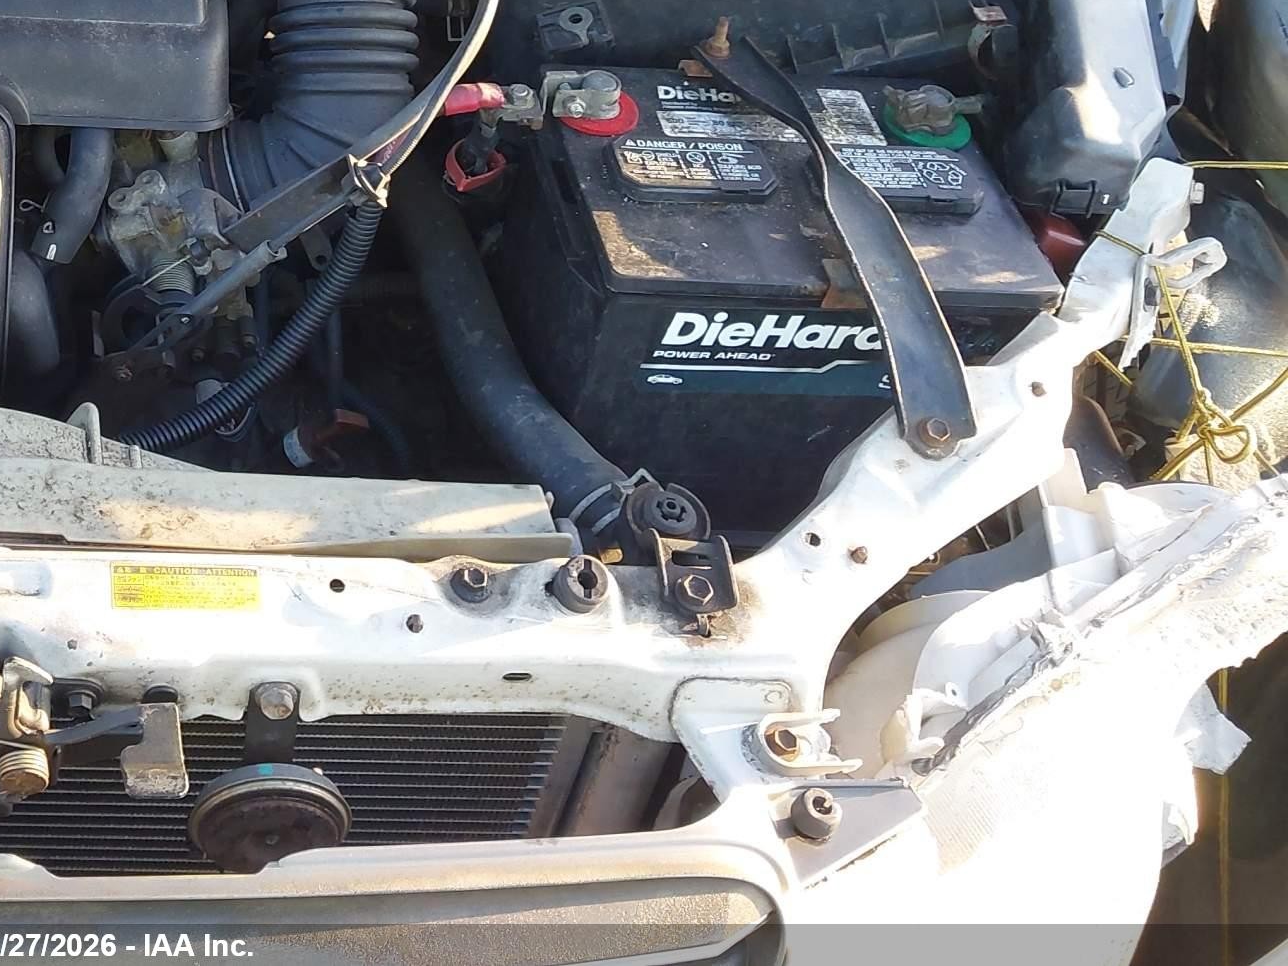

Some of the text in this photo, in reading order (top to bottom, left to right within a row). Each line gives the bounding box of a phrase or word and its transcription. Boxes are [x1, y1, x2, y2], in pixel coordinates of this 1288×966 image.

[656, 85, 742, 104] DieHa
[636, 139, 687, 150] DANGER
[698, 142, 744, 151] POISON
[652, 350, 711, 360] POWER
[153, 567, 200, 575] CAUTION
[205, 568, 256, 577] ATTENTION
